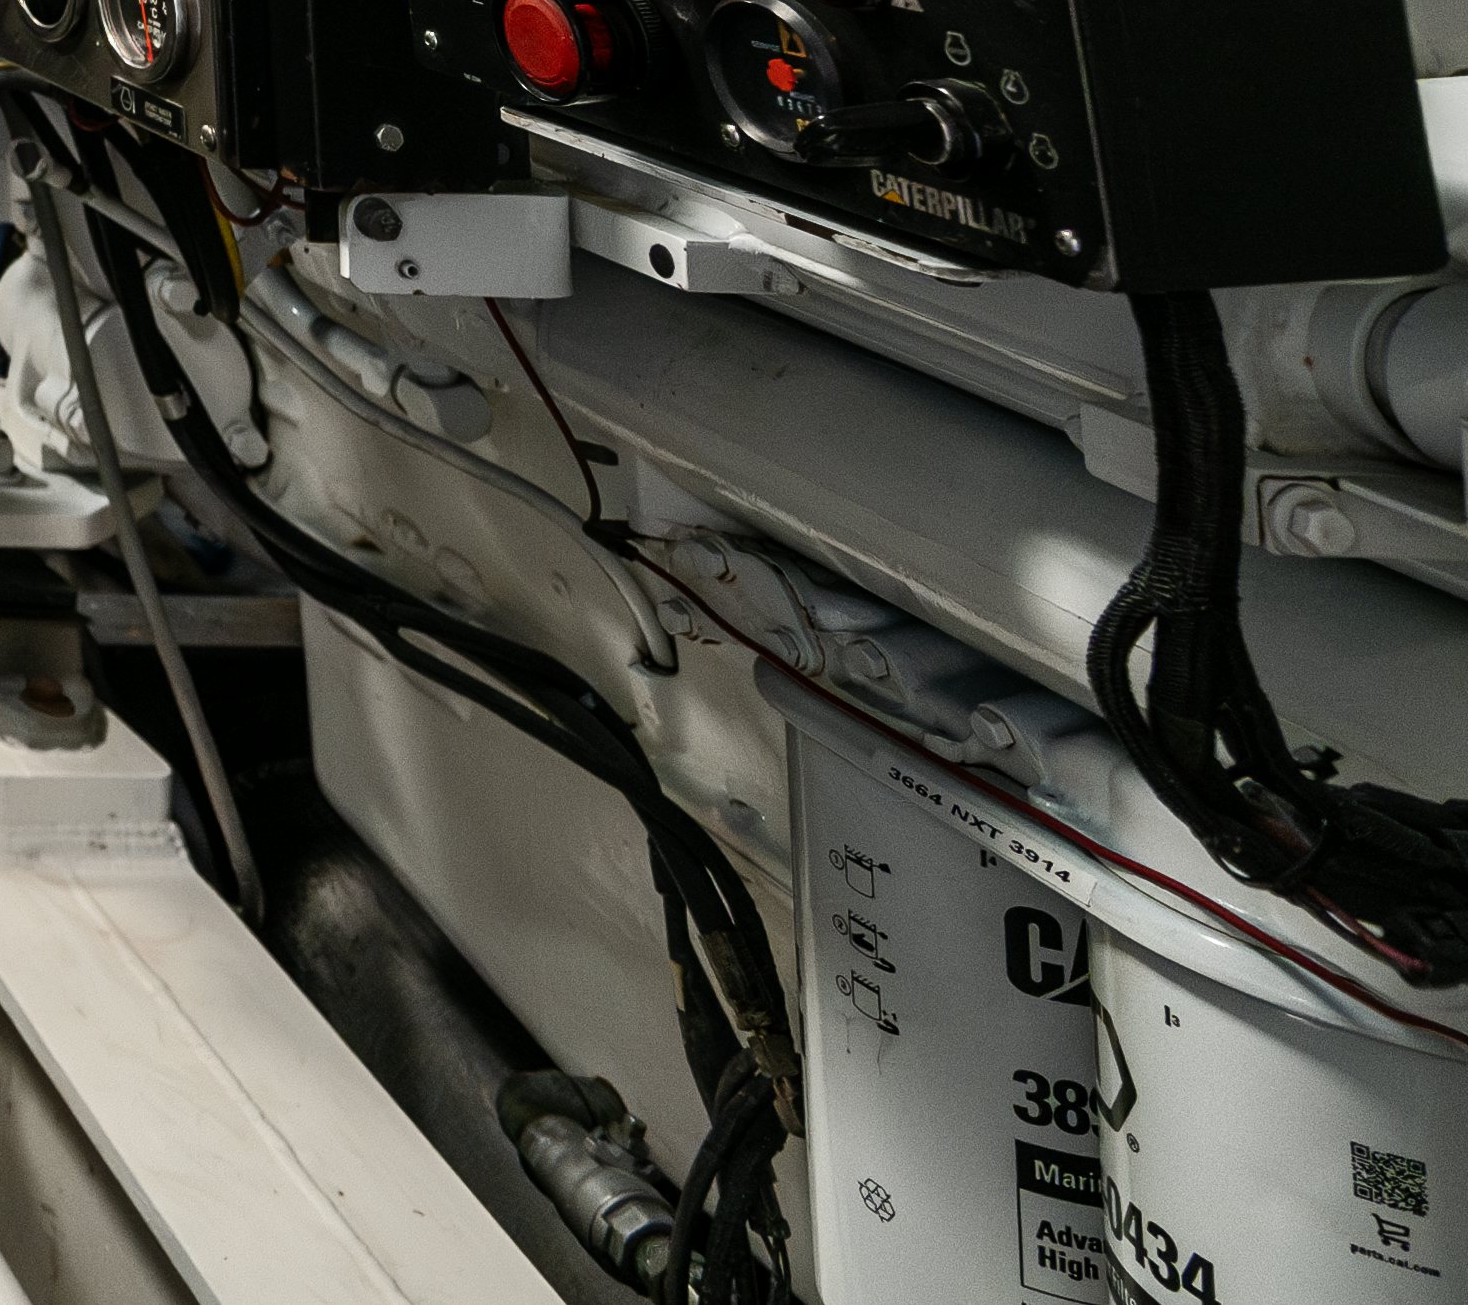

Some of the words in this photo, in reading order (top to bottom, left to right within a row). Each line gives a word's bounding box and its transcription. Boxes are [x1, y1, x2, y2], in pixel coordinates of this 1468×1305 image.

[870, 169, 1028, 244] CATERPILLAR
[888, 767, 944, 806] 3664
[951, 803, 1004, 840] NXT
[1008, 839, 1071, 884] 3914
[1003, 905, 1091, 1007] CA
[1033, 1159, 1101, 1194] Mari
[1036, 1219, 1105, 1255] Adva
[1036, 1245, 1100, 1282] High
